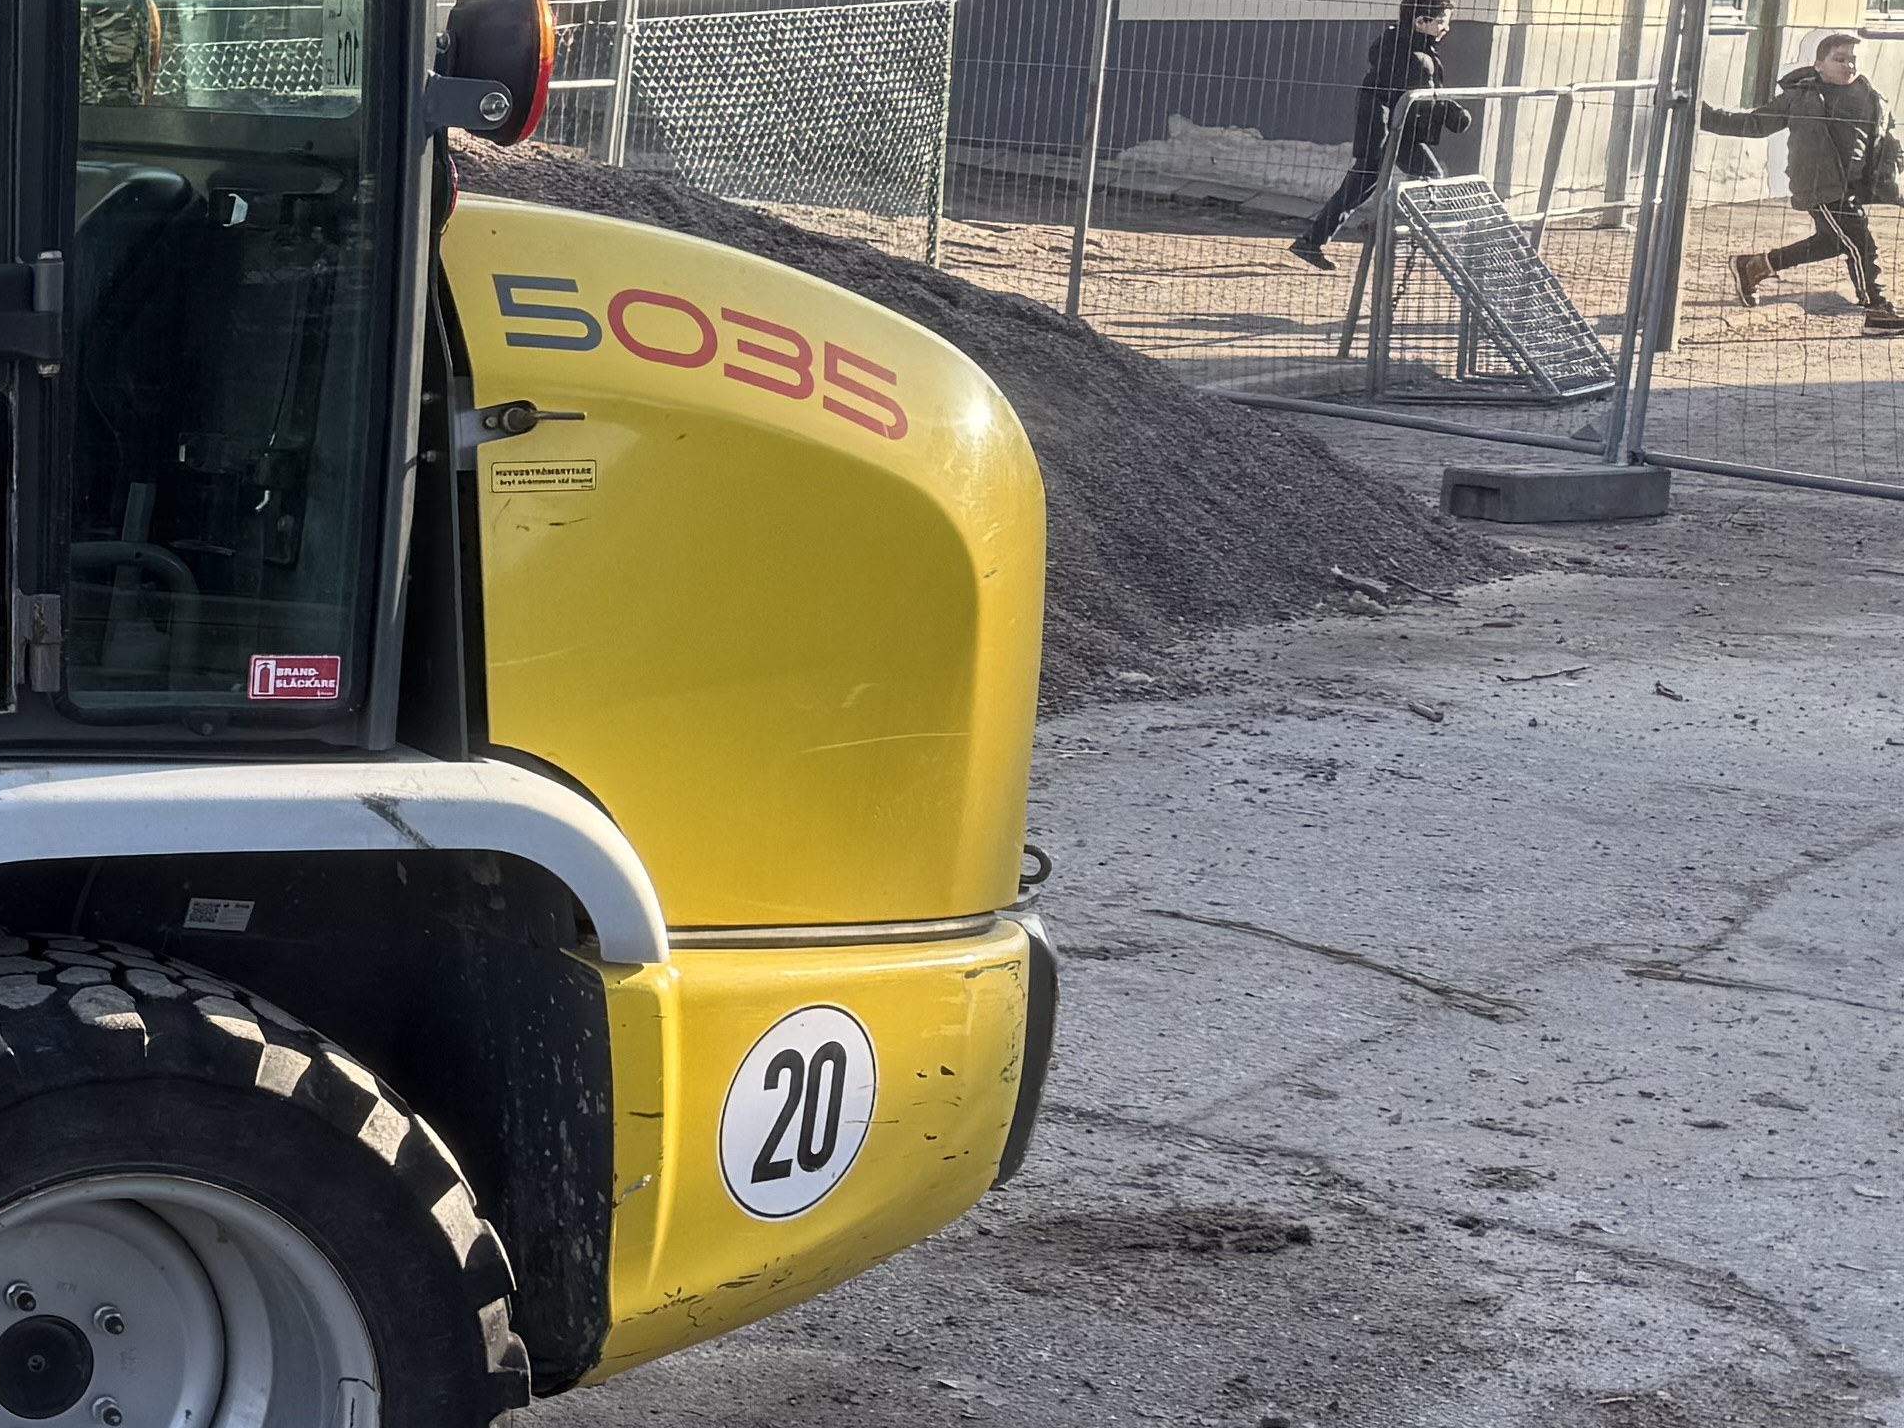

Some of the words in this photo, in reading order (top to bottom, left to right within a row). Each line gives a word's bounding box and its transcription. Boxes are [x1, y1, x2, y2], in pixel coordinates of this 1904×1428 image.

[492, 274, 908, 440] 5035
[276, 667, 319, 676] BRAND-
[751, 1041, 847, 1184] 20
